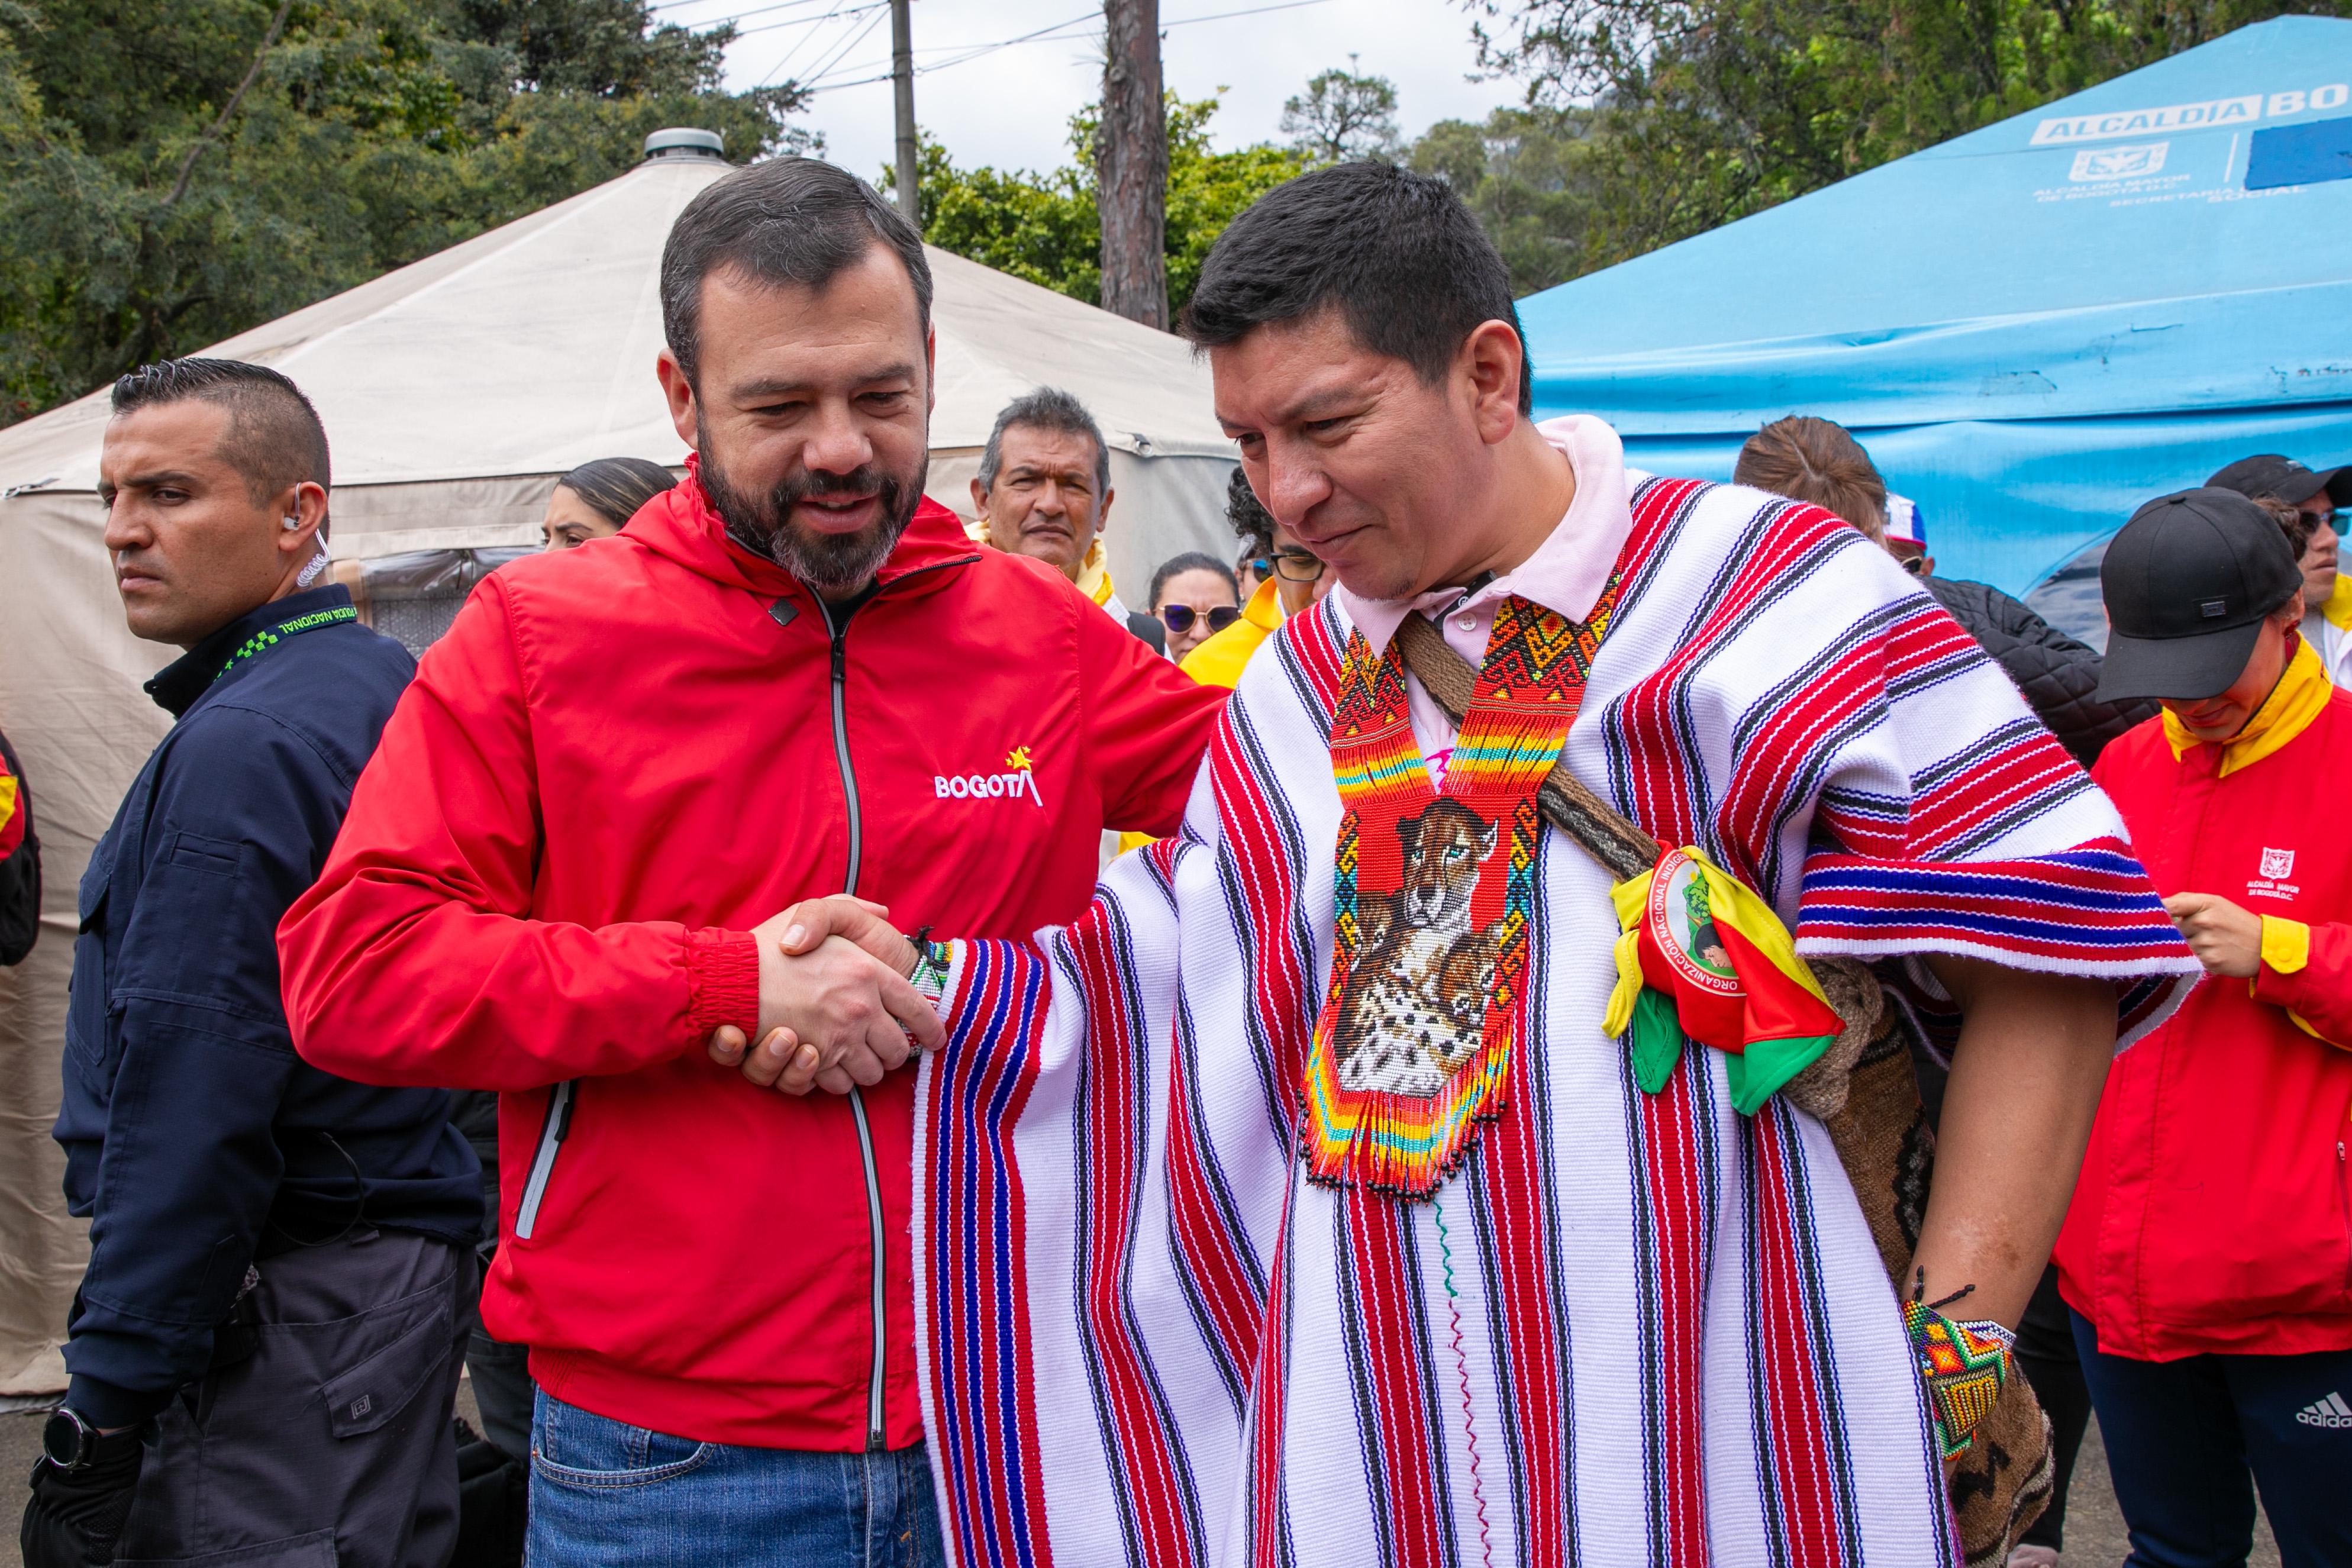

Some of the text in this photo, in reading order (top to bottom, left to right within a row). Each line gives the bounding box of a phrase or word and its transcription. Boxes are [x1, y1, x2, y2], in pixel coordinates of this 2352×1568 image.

[2047, 101, 2247, 138] ALCALDÍA
[2207, 185, 2308, 204] SOCIAL
[278, 611, 333, 634] NACIONAL
[1654, 882, 1670, 938] NACIONAL
[1664, 938, 1738, 991] ORGANIZACIÓN
